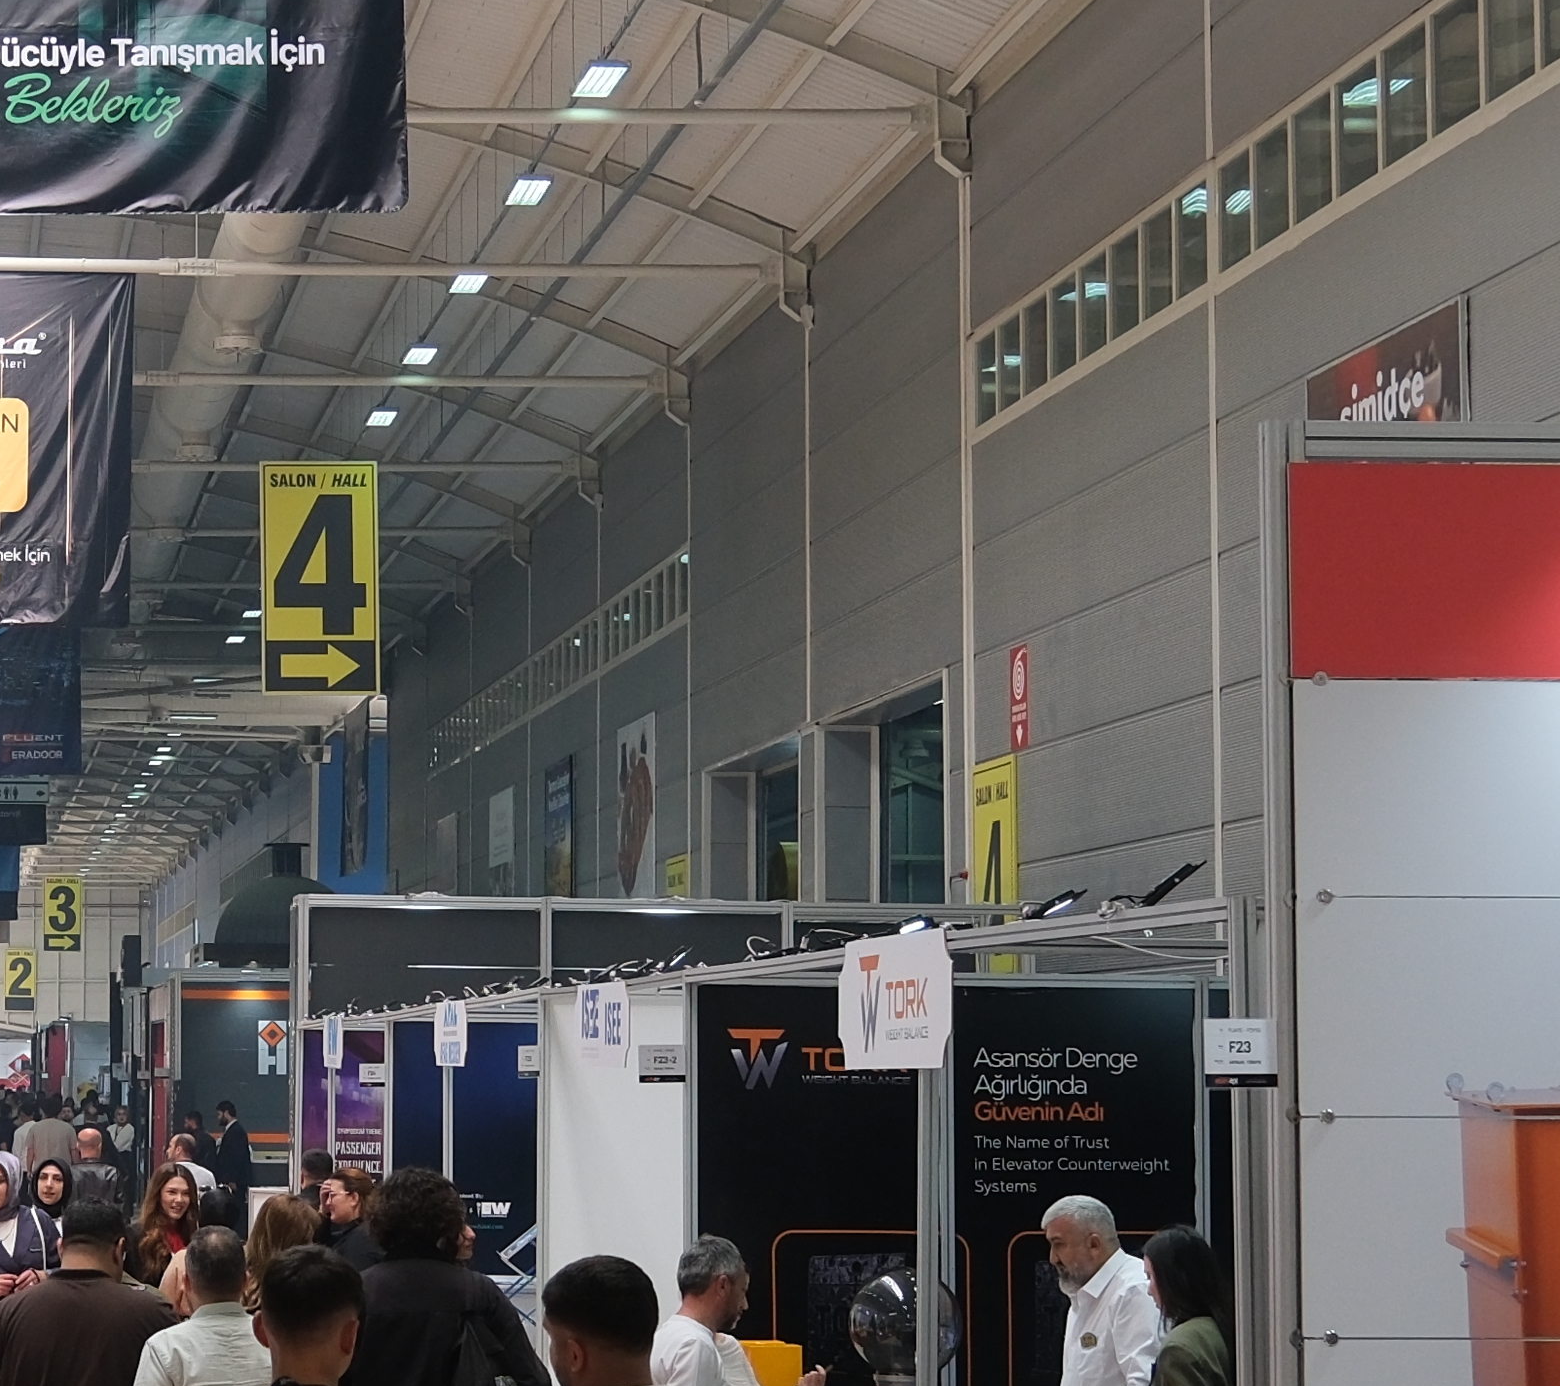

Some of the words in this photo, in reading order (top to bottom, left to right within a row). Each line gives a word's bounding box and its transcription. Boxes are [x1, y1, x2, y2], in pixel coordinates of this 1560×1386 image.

[111, 38, 266, 73] Tanışmak
[270, 29, 326, 72] İçin
[5, 73, 183, 139] Bekleriz
[270, 473, 316, 488] SALON
[331, 473, 367, 488] HALL
[25, 544, 51, 566] İçin
[274, 494, 367, 636] 4
[2, 733, 64, 742] FLUENT
[975, 783, 992, 807] SALON
[996, 780, 1009, 801] HALL
[49, 885, 76, 933] 3
[8, 957, 32, 996] 2
[885, 977, 929, 1020] TORK
[604, 1001, 622, 1046] ISEE
[903, 1025, 929, 1040] BALANCE
[1228, 1040, 1252, 1054] F23
[973, 1046, 1063, 1068] Asansör
[1065, 1047, 1138, 1075] Denge
[802, 1075, 849, 1084] WEIGHT
[850, 1075, 912, 1086] BALANCE
[973, 1074, 1088, 1102] Ağırlığında
[974, 1100, 1064, 1122] Güvenin
[1067, 1101, 1105, 1122] Adı
[335, 1141, 382, 1155] PASSENGER
[974, 1135, 1002, 1149] The
[1006, 1135, 1050, 1149] Name
[1054, 1135, 1070, 1149] of
[1071, 1135, 1110, 1149] Trust
[974, 1157, 988, 1171] in
[992, 1157, 1054, 1171] Elevator
[1057, 1157, 1170, 1175] Counterweight
[974, 1179, 1038, 1197] Systems
